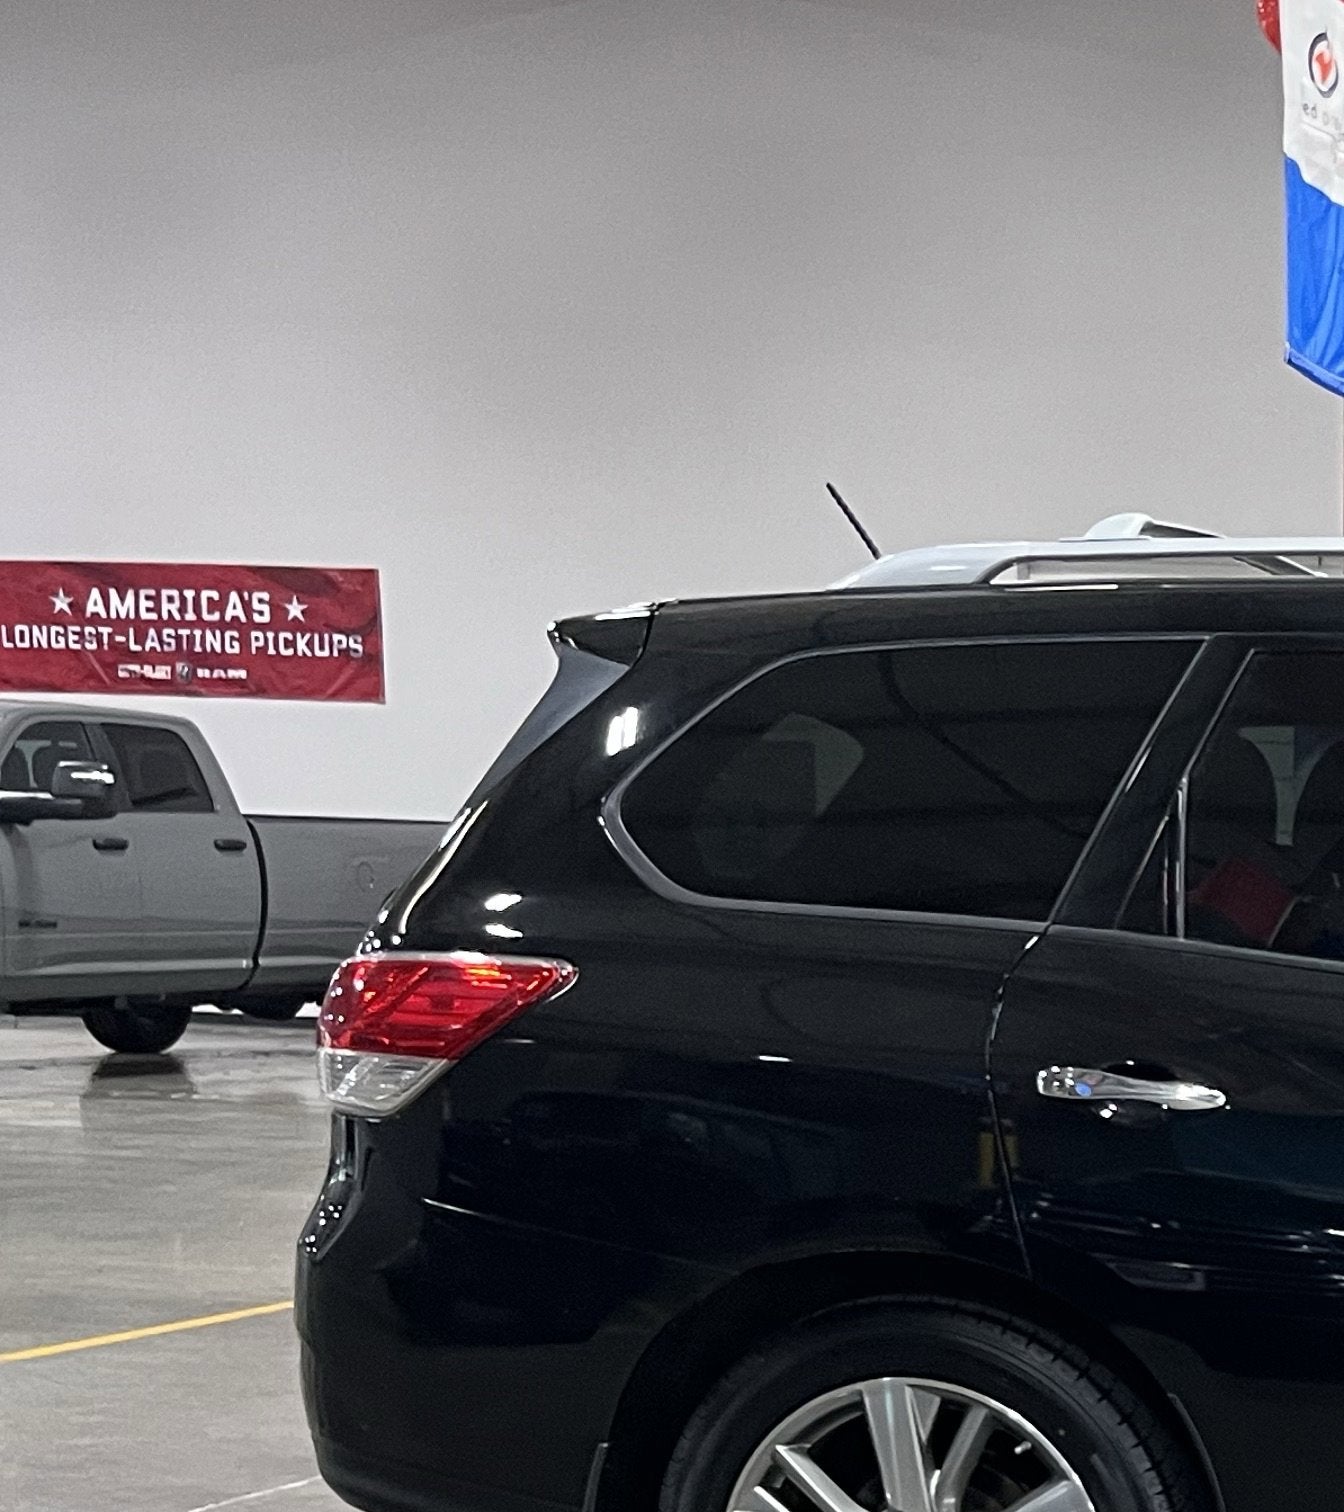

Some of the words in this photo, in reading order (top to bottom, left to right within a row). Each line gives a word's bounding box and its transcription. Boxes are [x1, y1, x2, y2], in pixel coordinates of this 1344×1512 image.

[84, 587, 271, 623] AMERICA'S
[1, 625, 240, 654] LONGEST-LASTING
[250, 631, 363, 657] PICKUPS
